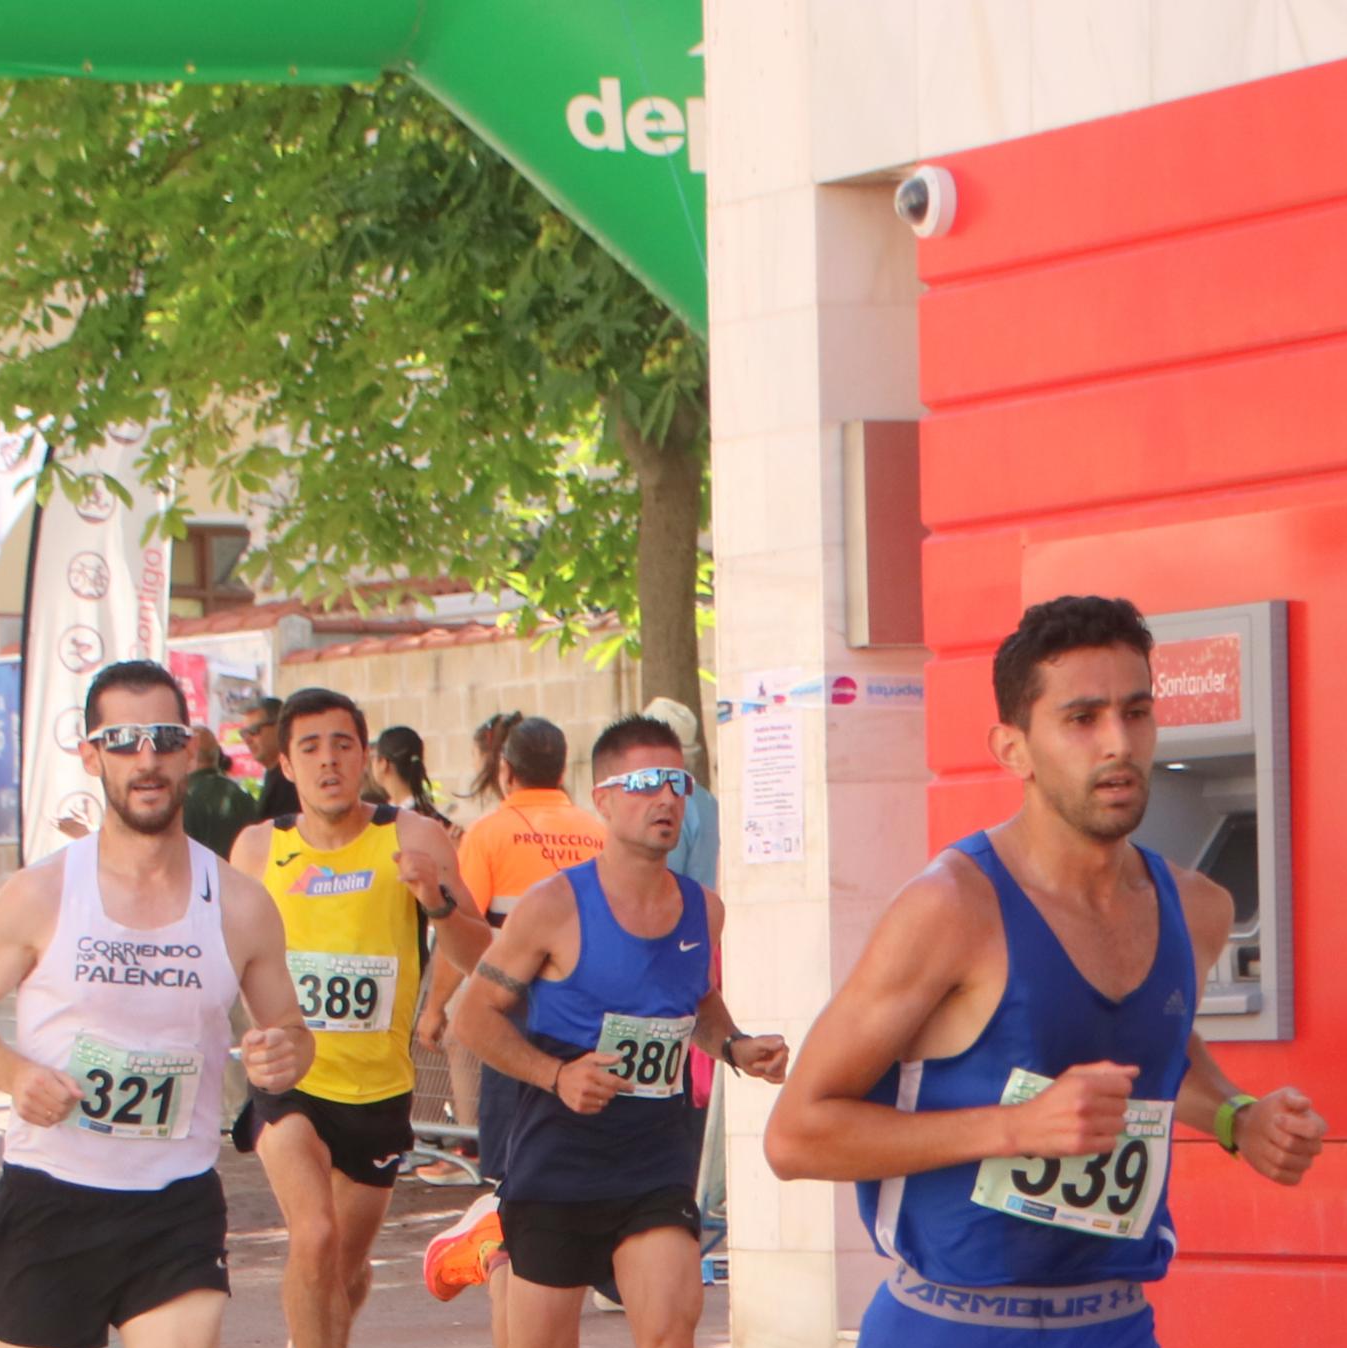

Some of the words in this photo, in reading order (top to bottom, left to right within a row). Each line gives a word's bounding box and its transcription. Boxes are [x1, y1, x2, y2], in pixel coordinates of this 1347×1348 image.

[566, 76, 706, 174] de
[1157, 669, 1228, 699] Santander
[541, 848, 582, 861] CIVIL
[77, 937, 203, 963] CORRIENDO
[75, 964, 203, 989] PALENCIA
[299, 974, 379, 1020] 389
[608, 1039, 683, 1085] 380
[80, 1068, 175, 1125] 321
[904, 1281, 1102, 1319] ARMOUR
